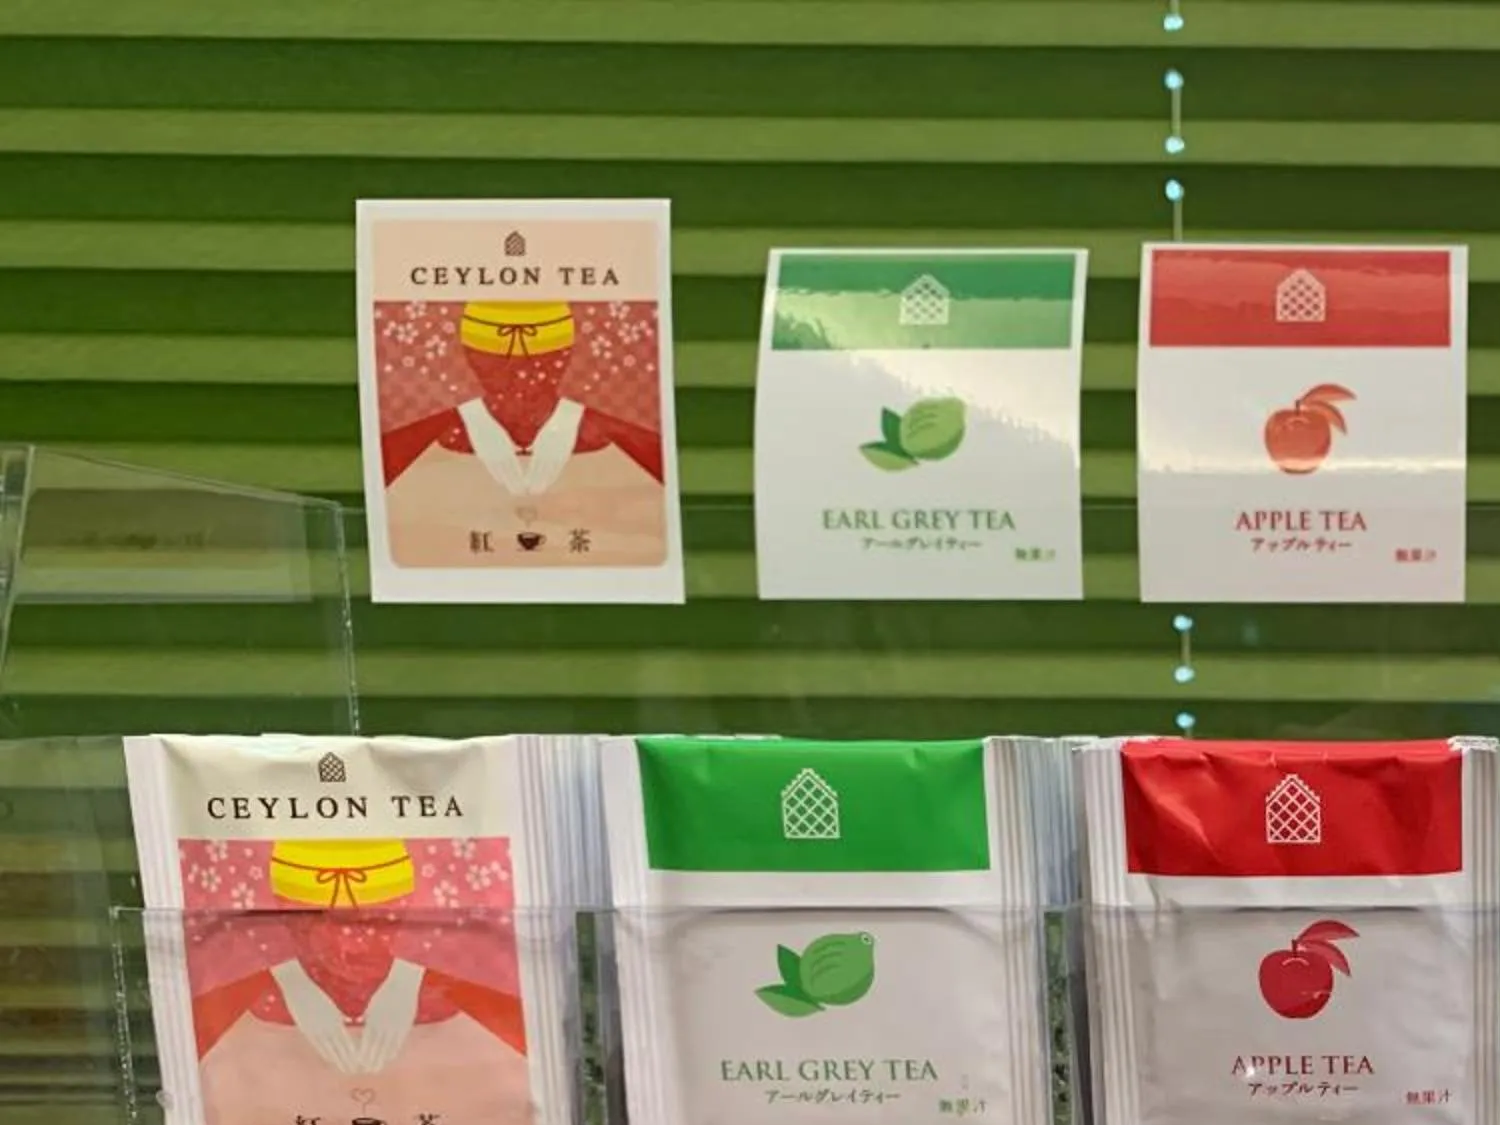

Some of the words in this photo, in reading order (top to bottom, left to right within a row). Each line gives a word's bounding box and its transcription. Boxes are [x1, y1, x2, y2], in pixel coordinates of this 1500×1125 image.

[411, 267, 541, 285] CEYLON
[559, 266, 619, 285] TEA
[822, 509, 884, 531] EARL
[891, 509, 960, 531] GREY
[968, 509, 1016, 531] TEA
[1235, 510, 1311, 532] APPLE
[1319, 510, 1367, 532] TEA
[469, 530, 494, 553] 紅
[570, 529, 591, 552] 茶
[207, 797, 368, 819] CEYLON
[391, 795, 464, 818] TEA
[721, 1060, 790, 1081] EARL
[797, 1060, 877, 1081] GREY
[881, 1059, 939, 1081] TEA
[1231, 1055, 1314, 1076] APPLE
[1320, 1055, 1375, 1076] TEA
[764, 1088, 902, 1105] アールグレイティー
[1247, 1081, 1359, 1098] アップルティー
